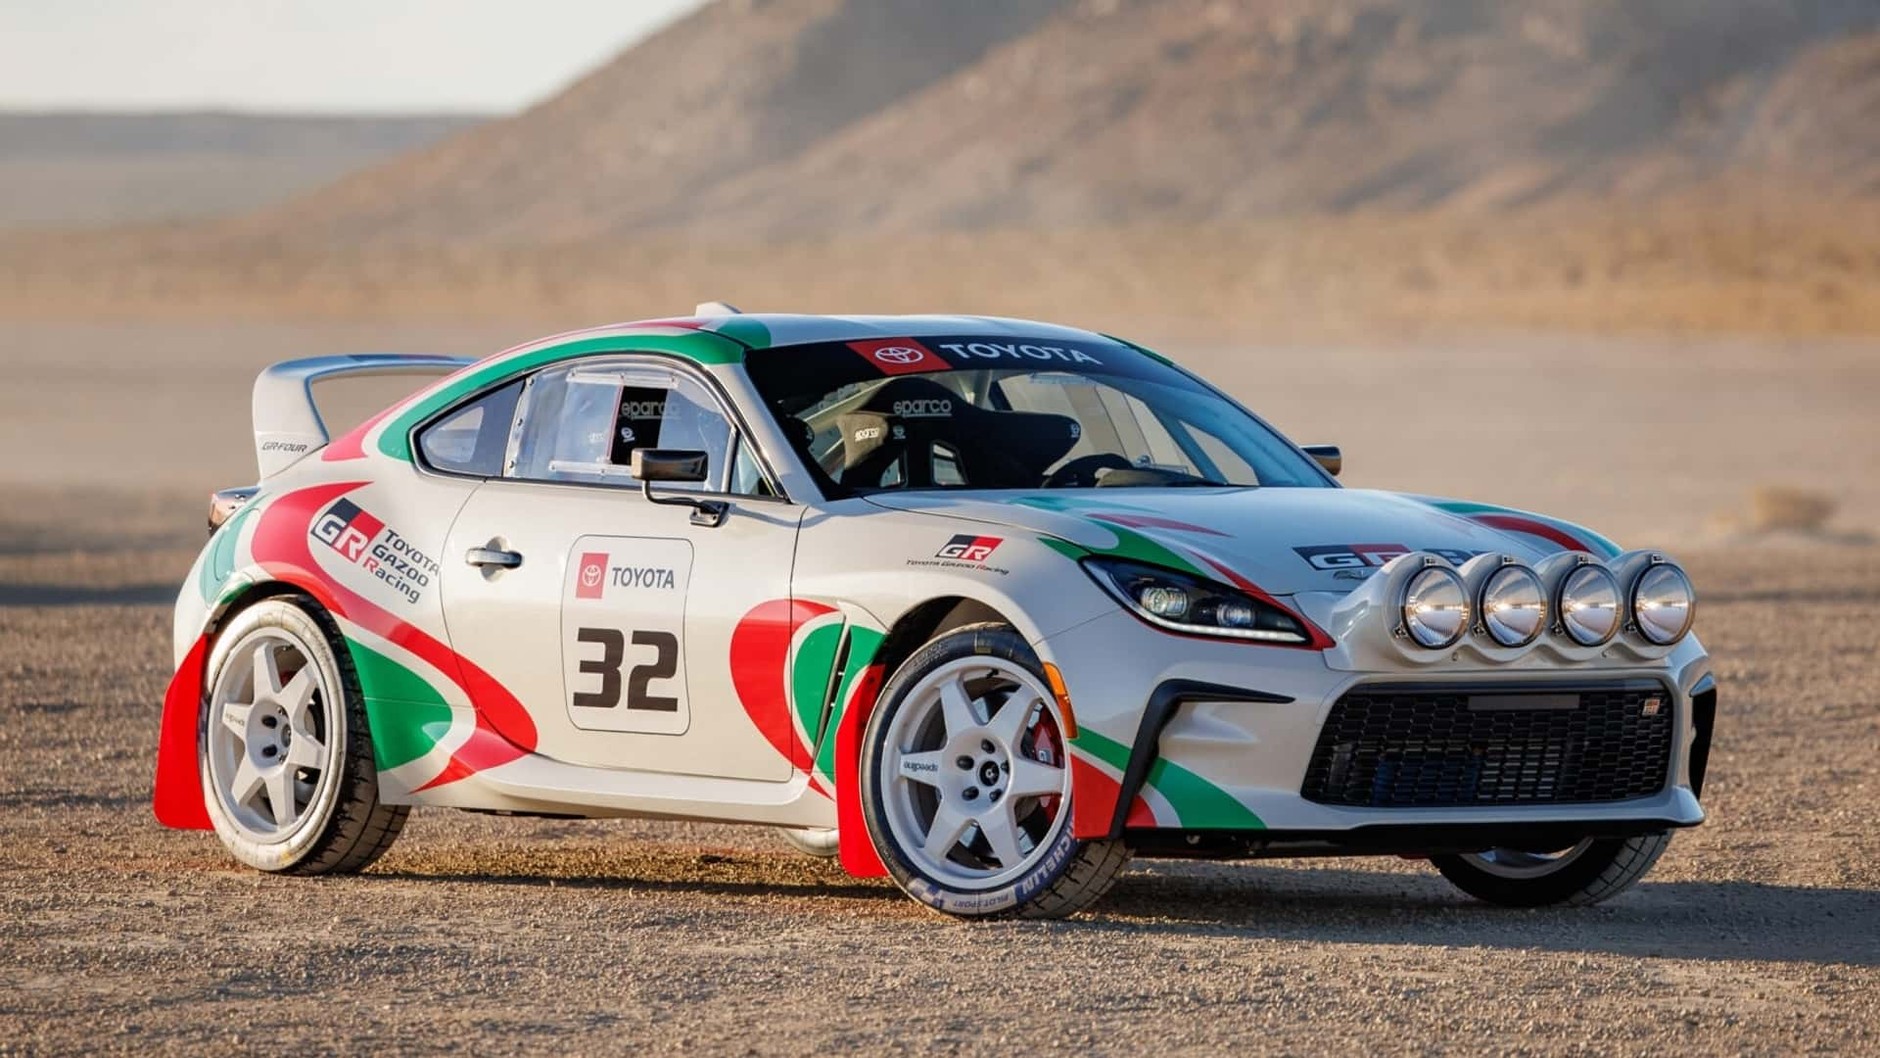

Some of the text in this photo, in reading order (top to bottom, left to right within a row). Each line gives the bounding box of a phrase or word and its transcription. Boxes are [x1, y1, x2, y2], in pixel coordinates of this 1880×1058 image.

[939, 343, 1103, 365] TOYOTA
[313, 512, 370, 562] GR
[384, 529, 441, 576] TOYOTA
[938, 544, 992, 560] GR
[362, 557, 420, 604] Racing
[372, 544, 429, 587] GAZOO
[612, 567, 675, 589] TOYOTA
[573, 627, 679, 712] 32
[1022, 818, 1074, 895] ICHELIN
